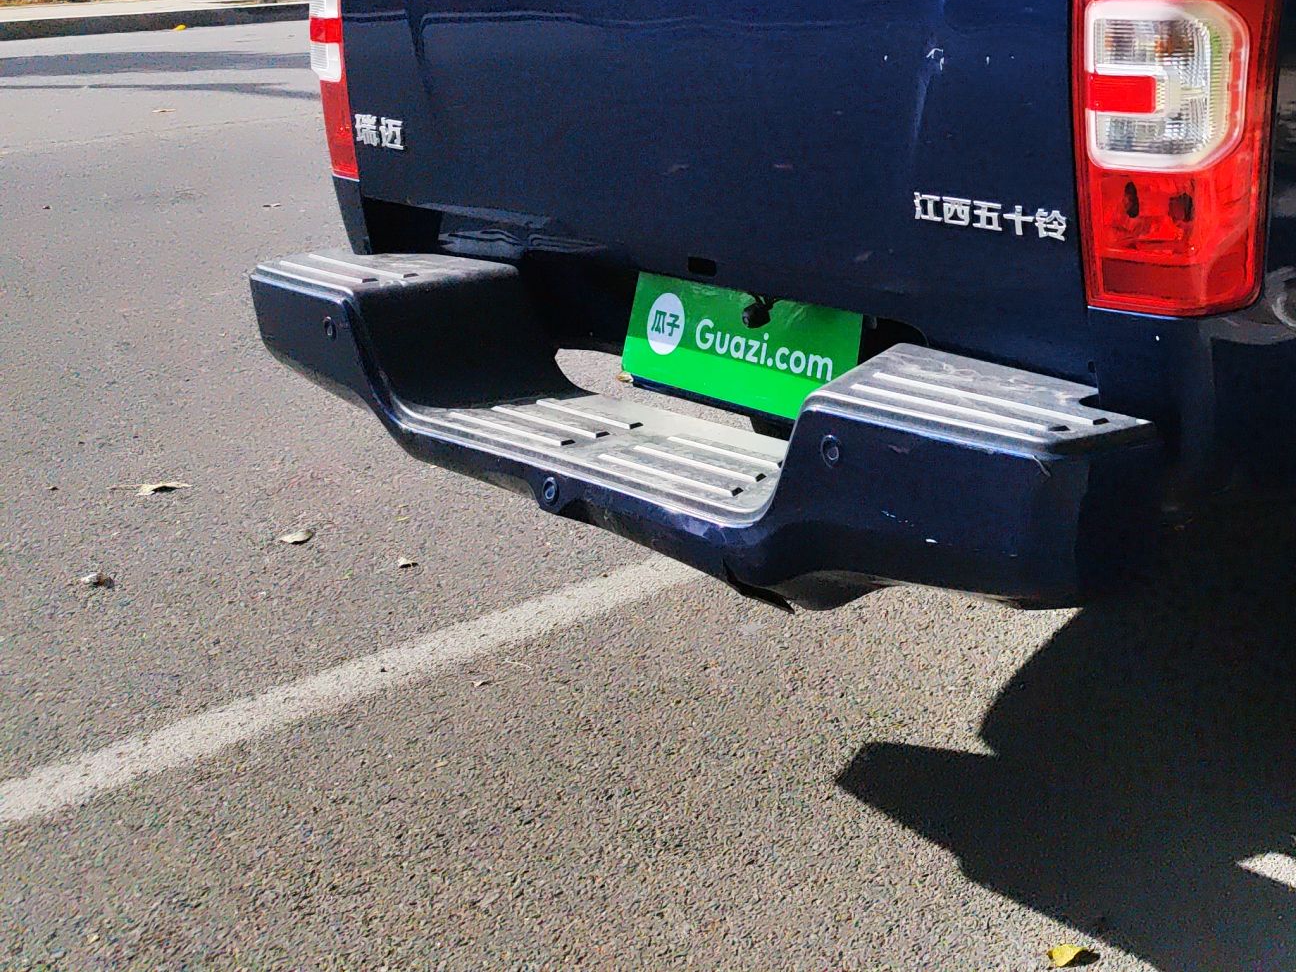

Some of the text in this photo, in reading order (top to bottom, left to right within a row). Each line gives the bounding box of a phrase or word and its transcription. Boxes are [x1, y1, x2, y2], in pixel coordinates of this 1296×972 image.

[354, 114, 404, 150] 瑞迈
[913, 191, 1068, 241] 江西五十铃
[651, 309, 681, 337] 瓜子
[695, 318, 833, 381] Guazi.com
